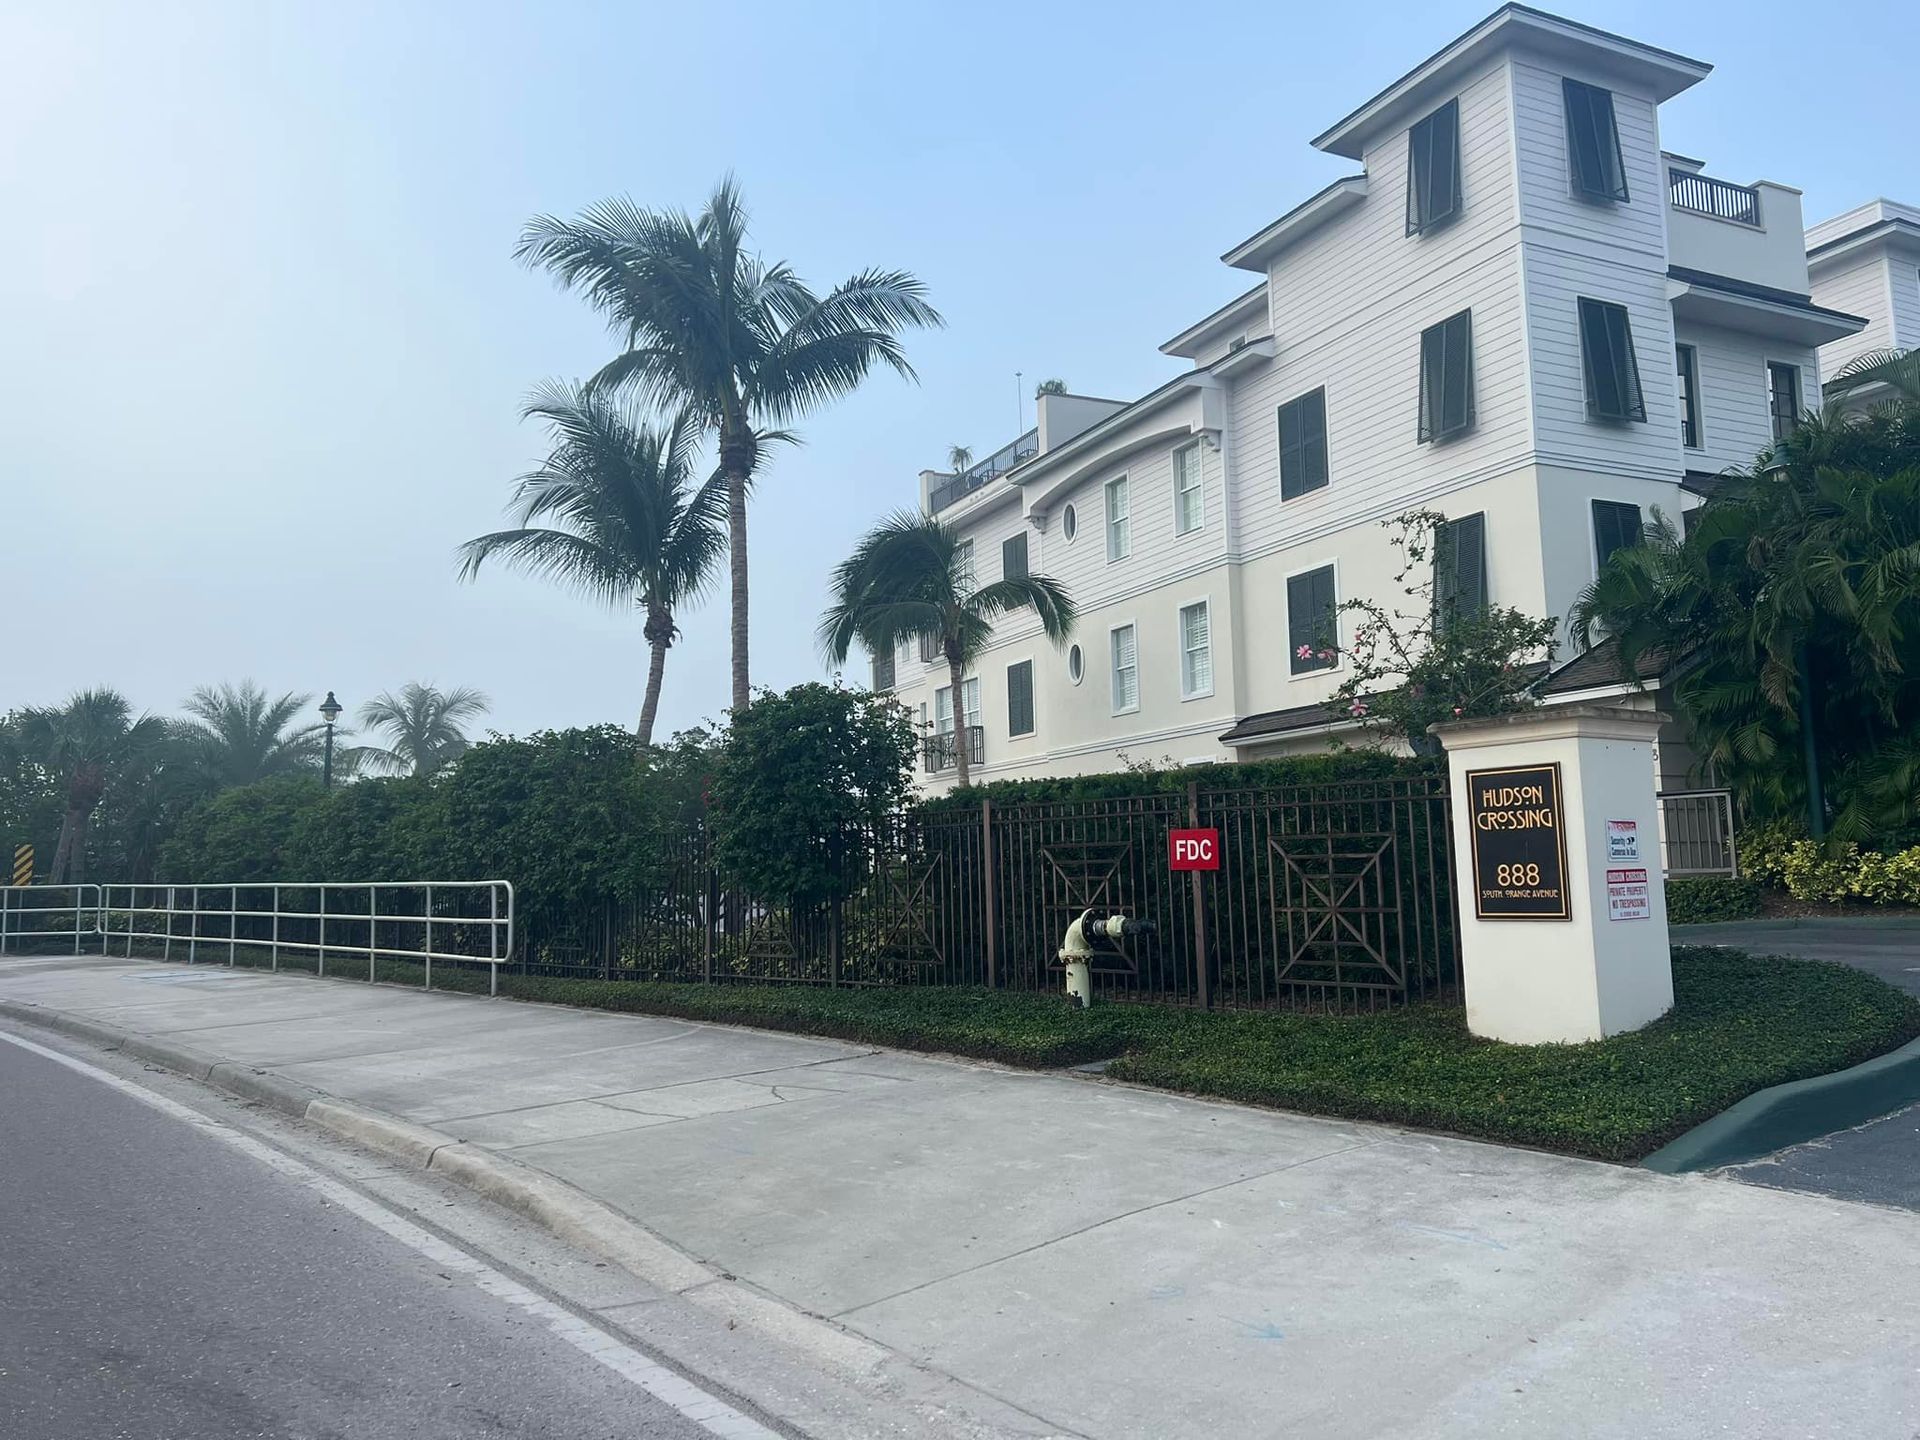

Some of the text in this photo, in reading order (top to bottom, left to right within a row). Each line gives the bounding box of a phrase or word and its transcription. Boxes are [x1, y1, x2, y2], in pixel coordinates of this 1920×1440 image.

[1483, 785, 1543, 807] HUDSON
[1477, 808, 1553, 830] CROSSING
[1176, 838, 1212, 861] FDC
[1497, 863, 1540, 886] 888
[1482, 889, 1559, 898] SOUTH ORANGE AVENUE
